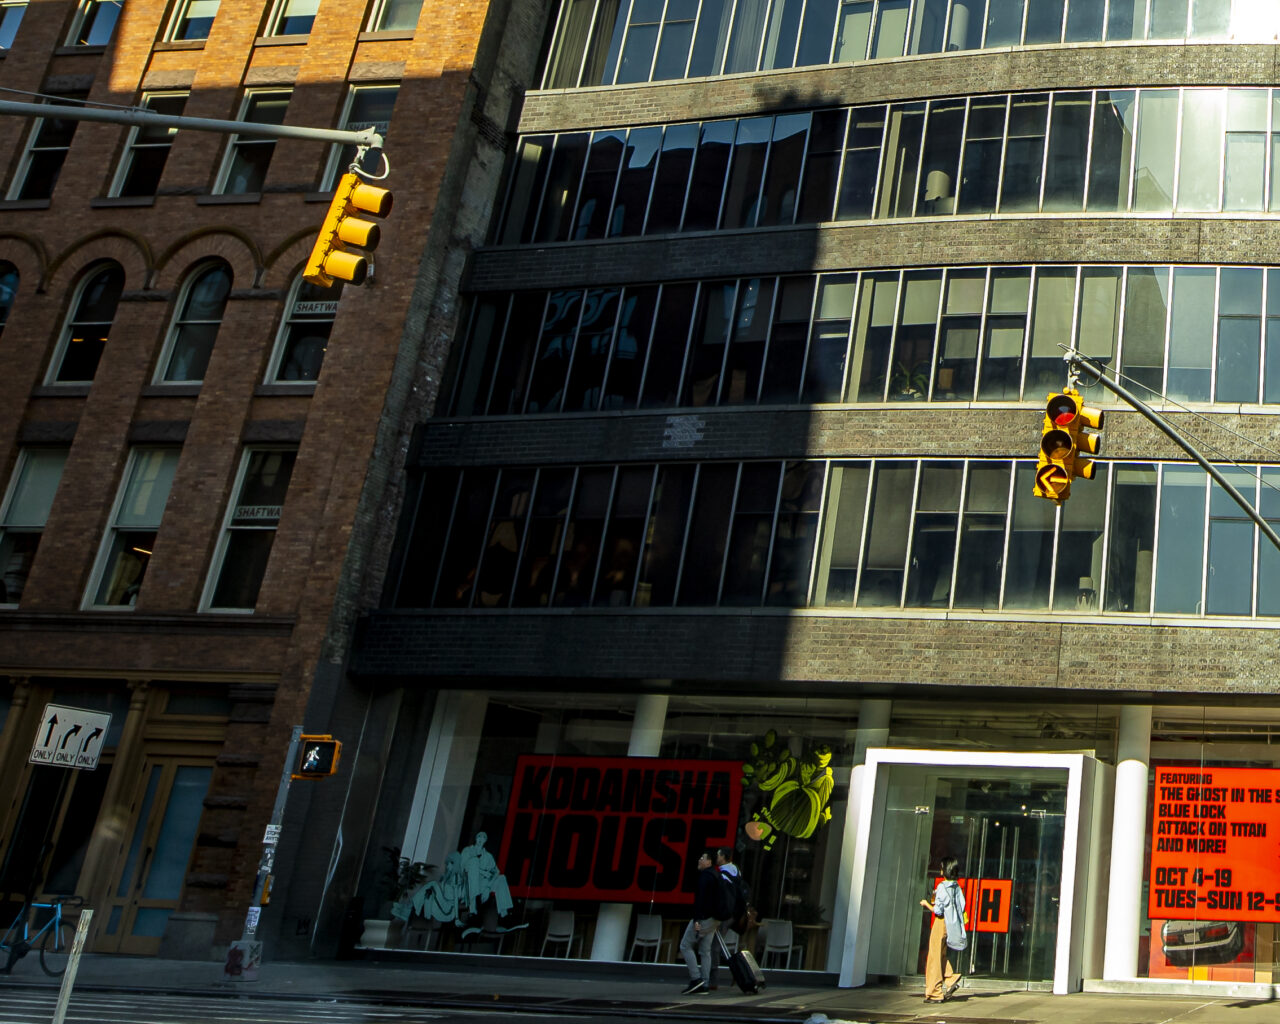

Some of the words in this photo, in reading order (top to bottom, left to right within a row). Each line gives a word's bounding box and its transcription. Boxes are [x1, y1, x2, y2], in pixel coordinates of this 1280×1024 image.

[34, 750, 52, 760] ONLY
[56, 752, 75, 762] ONLY
[78, 755, 96, 765] ONLY
[1160, 773, 1212, 784] FEATURING
[518, 765, 731, 816] KODANSHA
[1160, 787, 1183, 800] THE
[1187, 788, 1228, 802] GHOST
[1231, 789, 1245, 802] IN
[1248, 789, 1272, 803] THE
[1159, 804, 1190, 818] BLUE
[1193, 805, 1226, 819] LOCK
[1157, 821, 1205, 835] ATTACK
[1209, 822, 1226, 836] ON
[1230, 823, 1266, 837] TITAN
[503, 812, 728, 893] HOUSE
[1157, 838, 1183, 852] AND
[1187, 839, 1226, 853] MORE!
[1156, 868, 1188, 886] OCT
[980, 889, 1001, 922] H
